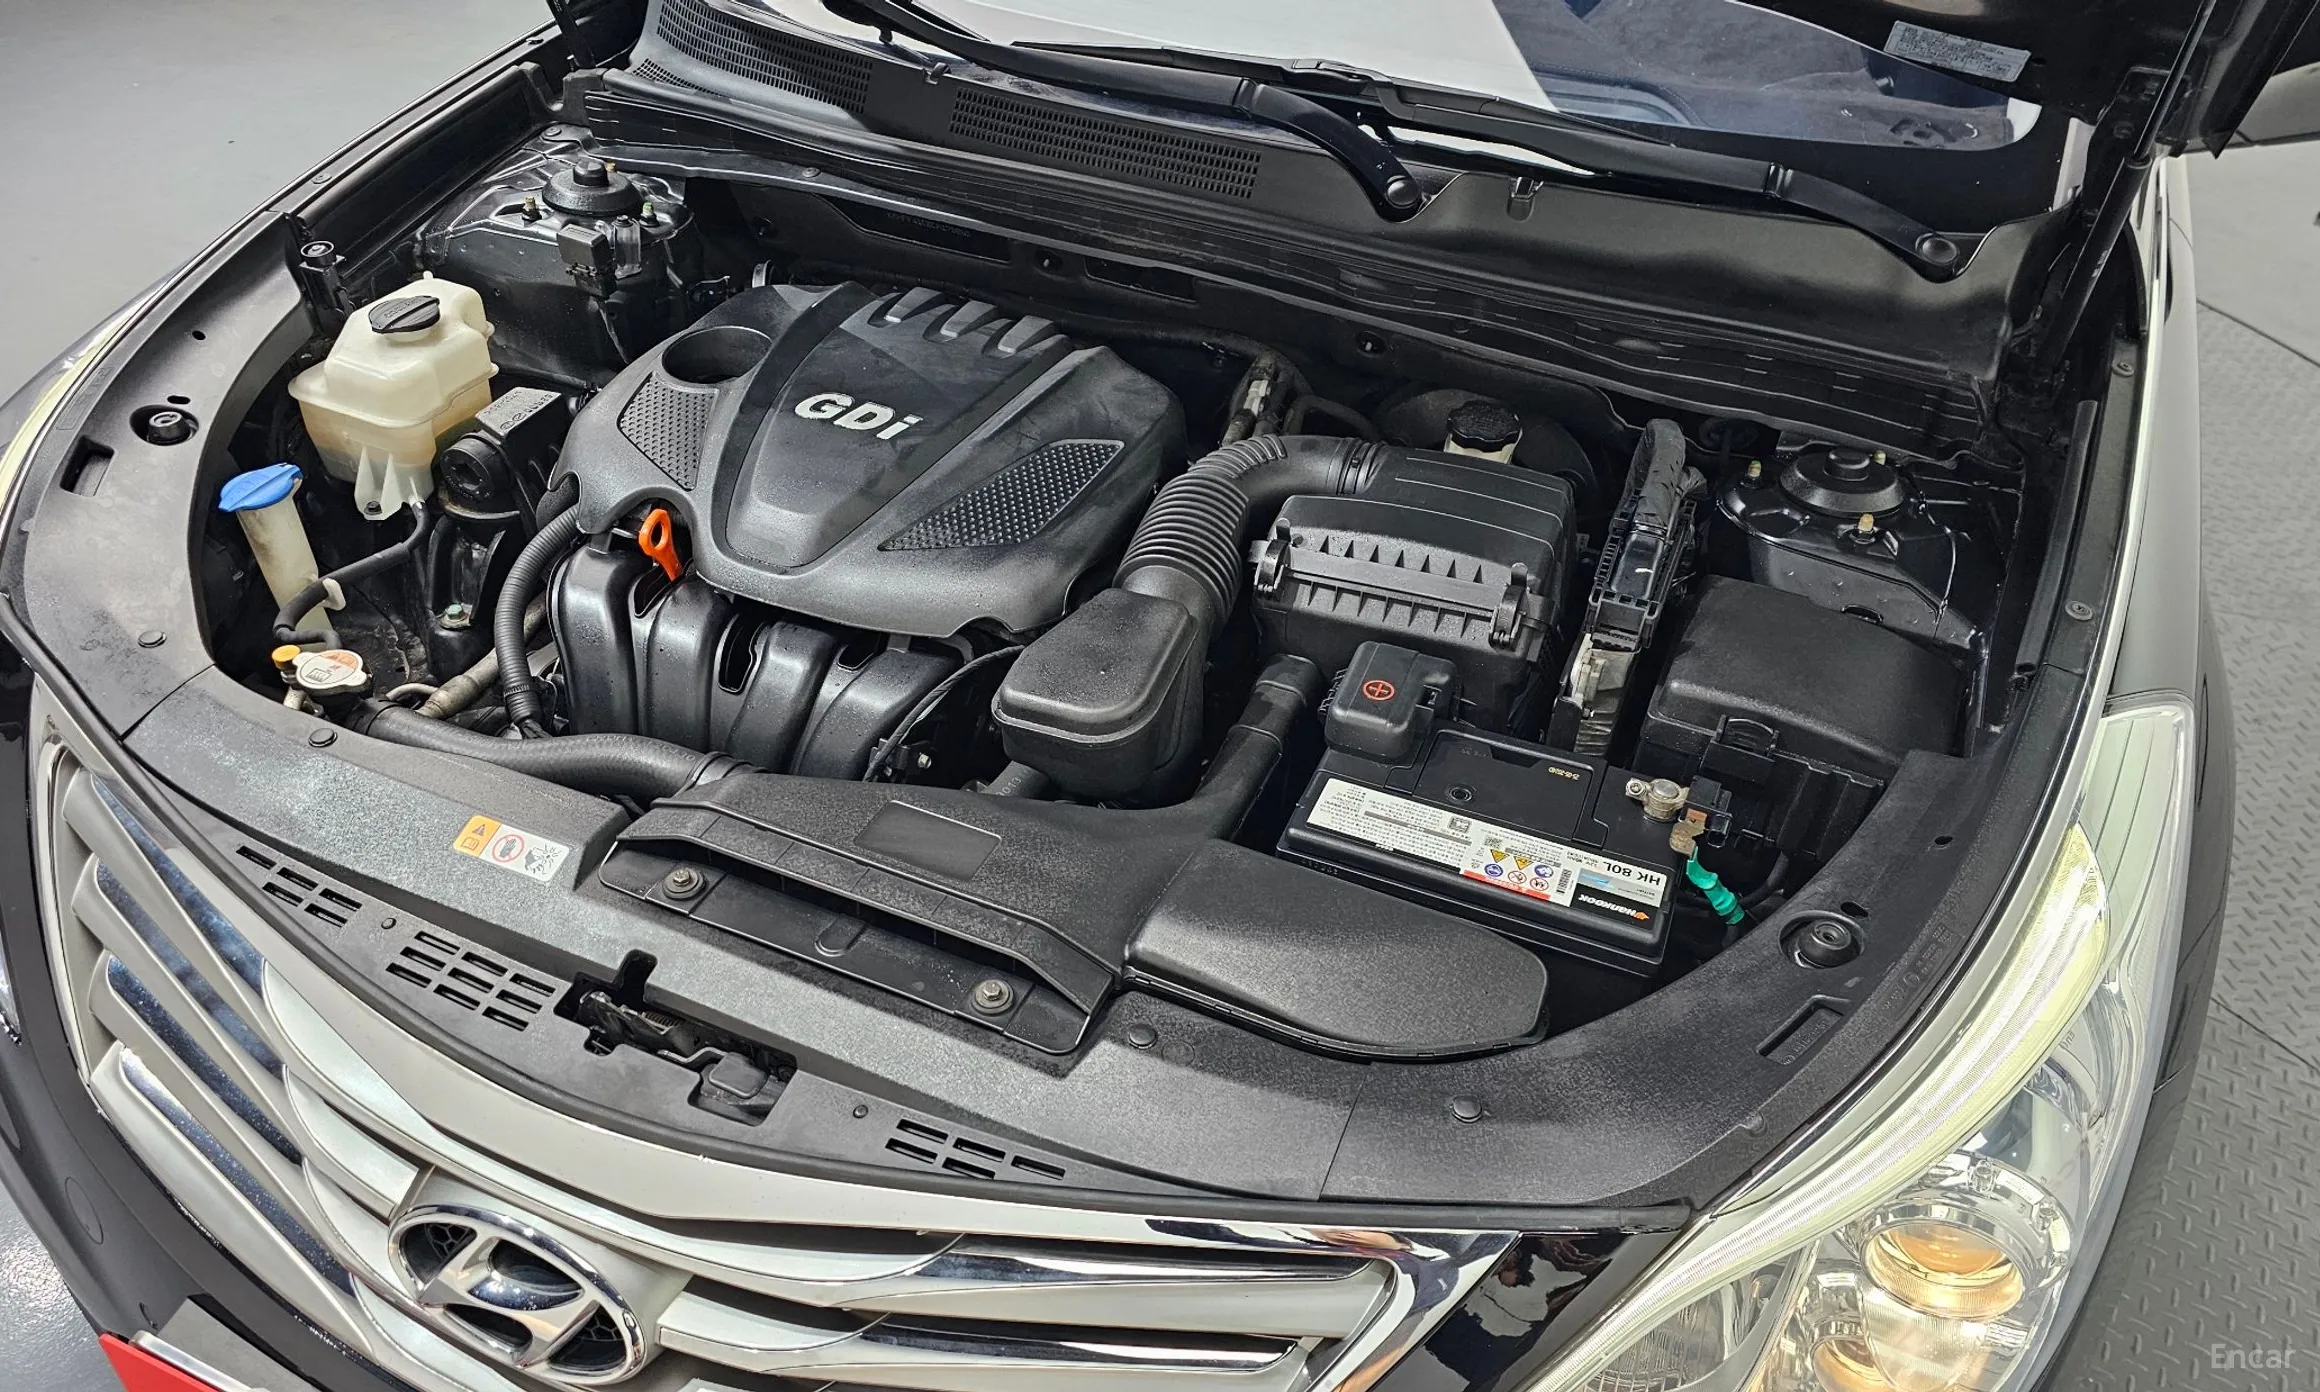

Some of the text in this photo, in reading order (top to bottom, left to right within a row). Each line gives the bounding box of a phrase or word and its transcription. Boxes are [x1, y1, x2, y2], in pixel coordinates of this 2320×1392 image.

[794, 391, 924, 440] GDi
[1603, 861, 1661, 886] HK 80L
